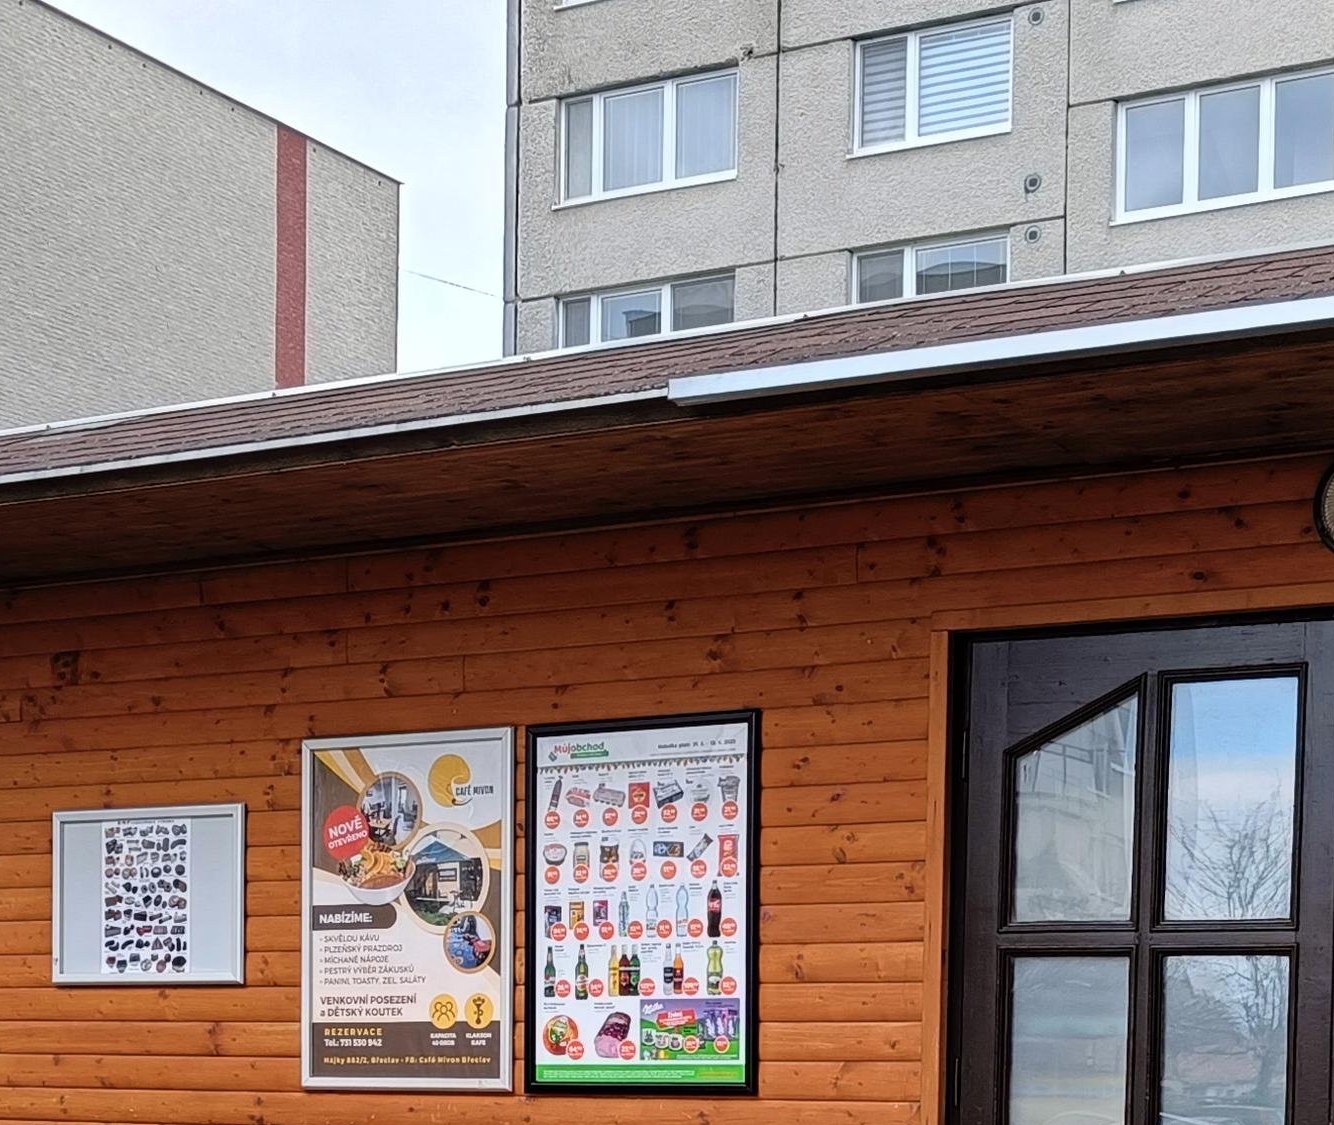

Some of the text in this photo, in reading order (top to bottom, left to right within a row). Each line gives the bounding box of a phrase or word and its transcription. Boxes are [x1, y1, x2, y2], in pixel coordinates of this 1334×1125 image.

[328, 814, 364, 839] NOVÉ
[328, 830, 368, 849] OTEVŘENO
[319, 911, 373, 924] NABÍZÍME:
[320, 993, 417, 1005] VENKOVNÍ POSEZENÍ
[327, 1006, 364, 1017] DĚTSKÝ
[365, 1007, 403, 1016] KOUTEK
[324, 1027, 383, 1036] REZERVACE
